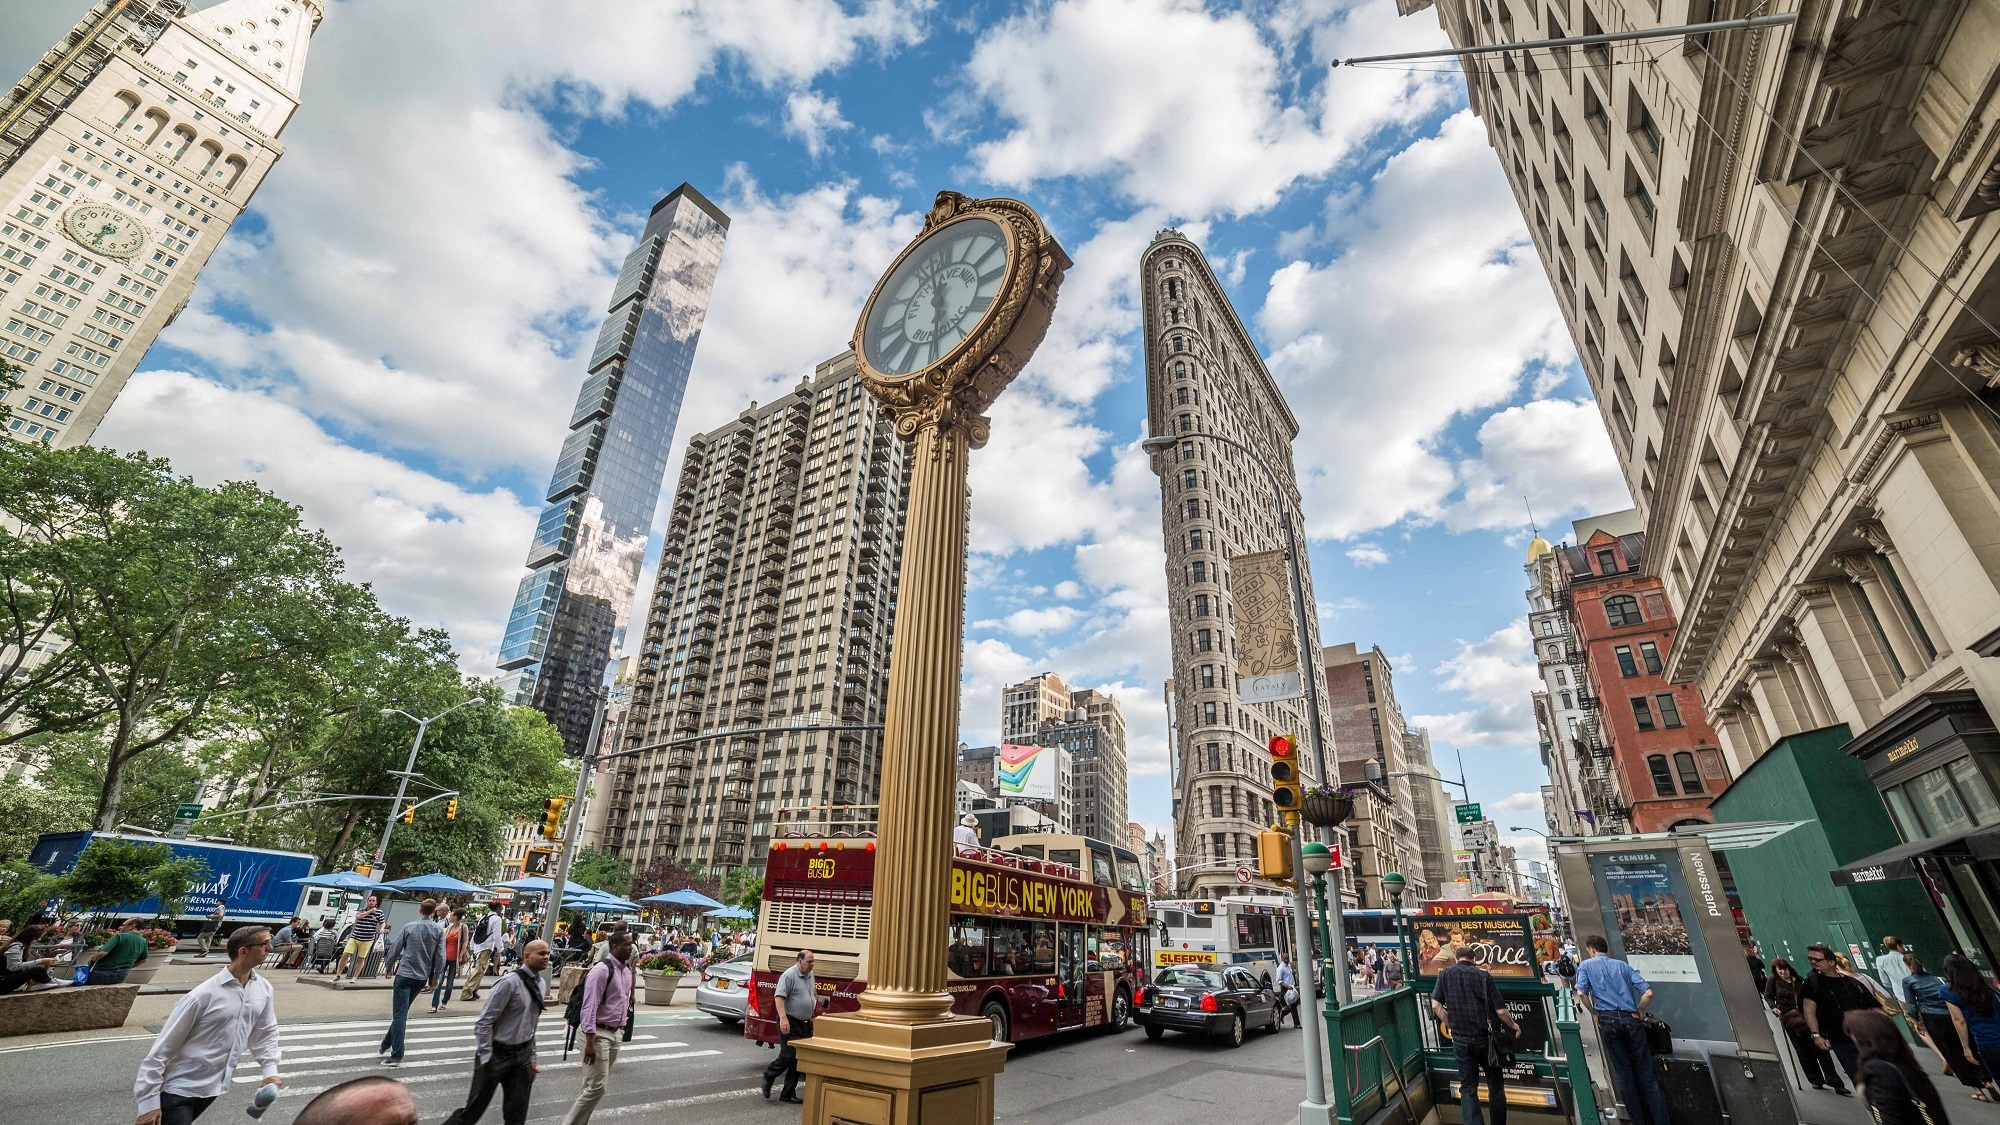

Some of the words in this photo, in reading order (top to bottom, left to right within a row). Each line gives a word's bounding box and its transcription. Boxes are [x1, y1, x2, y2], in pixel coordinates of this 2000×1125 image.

[908, 283, 933, 320] FIFTH
[939, 267, 975, 288] AVENUE
[1235, 579, 1262, 598] MAD.
[1242, 593, 1261, 608] SQ.
[1249, 596, 1276, 618] EATS.
[1255, 682, 1286, 692] EATALY
[1887, 737, 1918, 762] marimekko
[808, 858, 824, 869] BIG
[808, 868, 823, 878] BUS
[1852, 866, 1886, 882] marimekko
[1690, 852, 1721, 916] Newsstand
[1022, 879, 1058, 914] NEW
[1060, 885, 1094, 918] YORK
[1414, 922, 1418, 930] 8
[1461, 921, 1482, 929] BEST
[1484, 921, 1522, 929] MUSICAL
